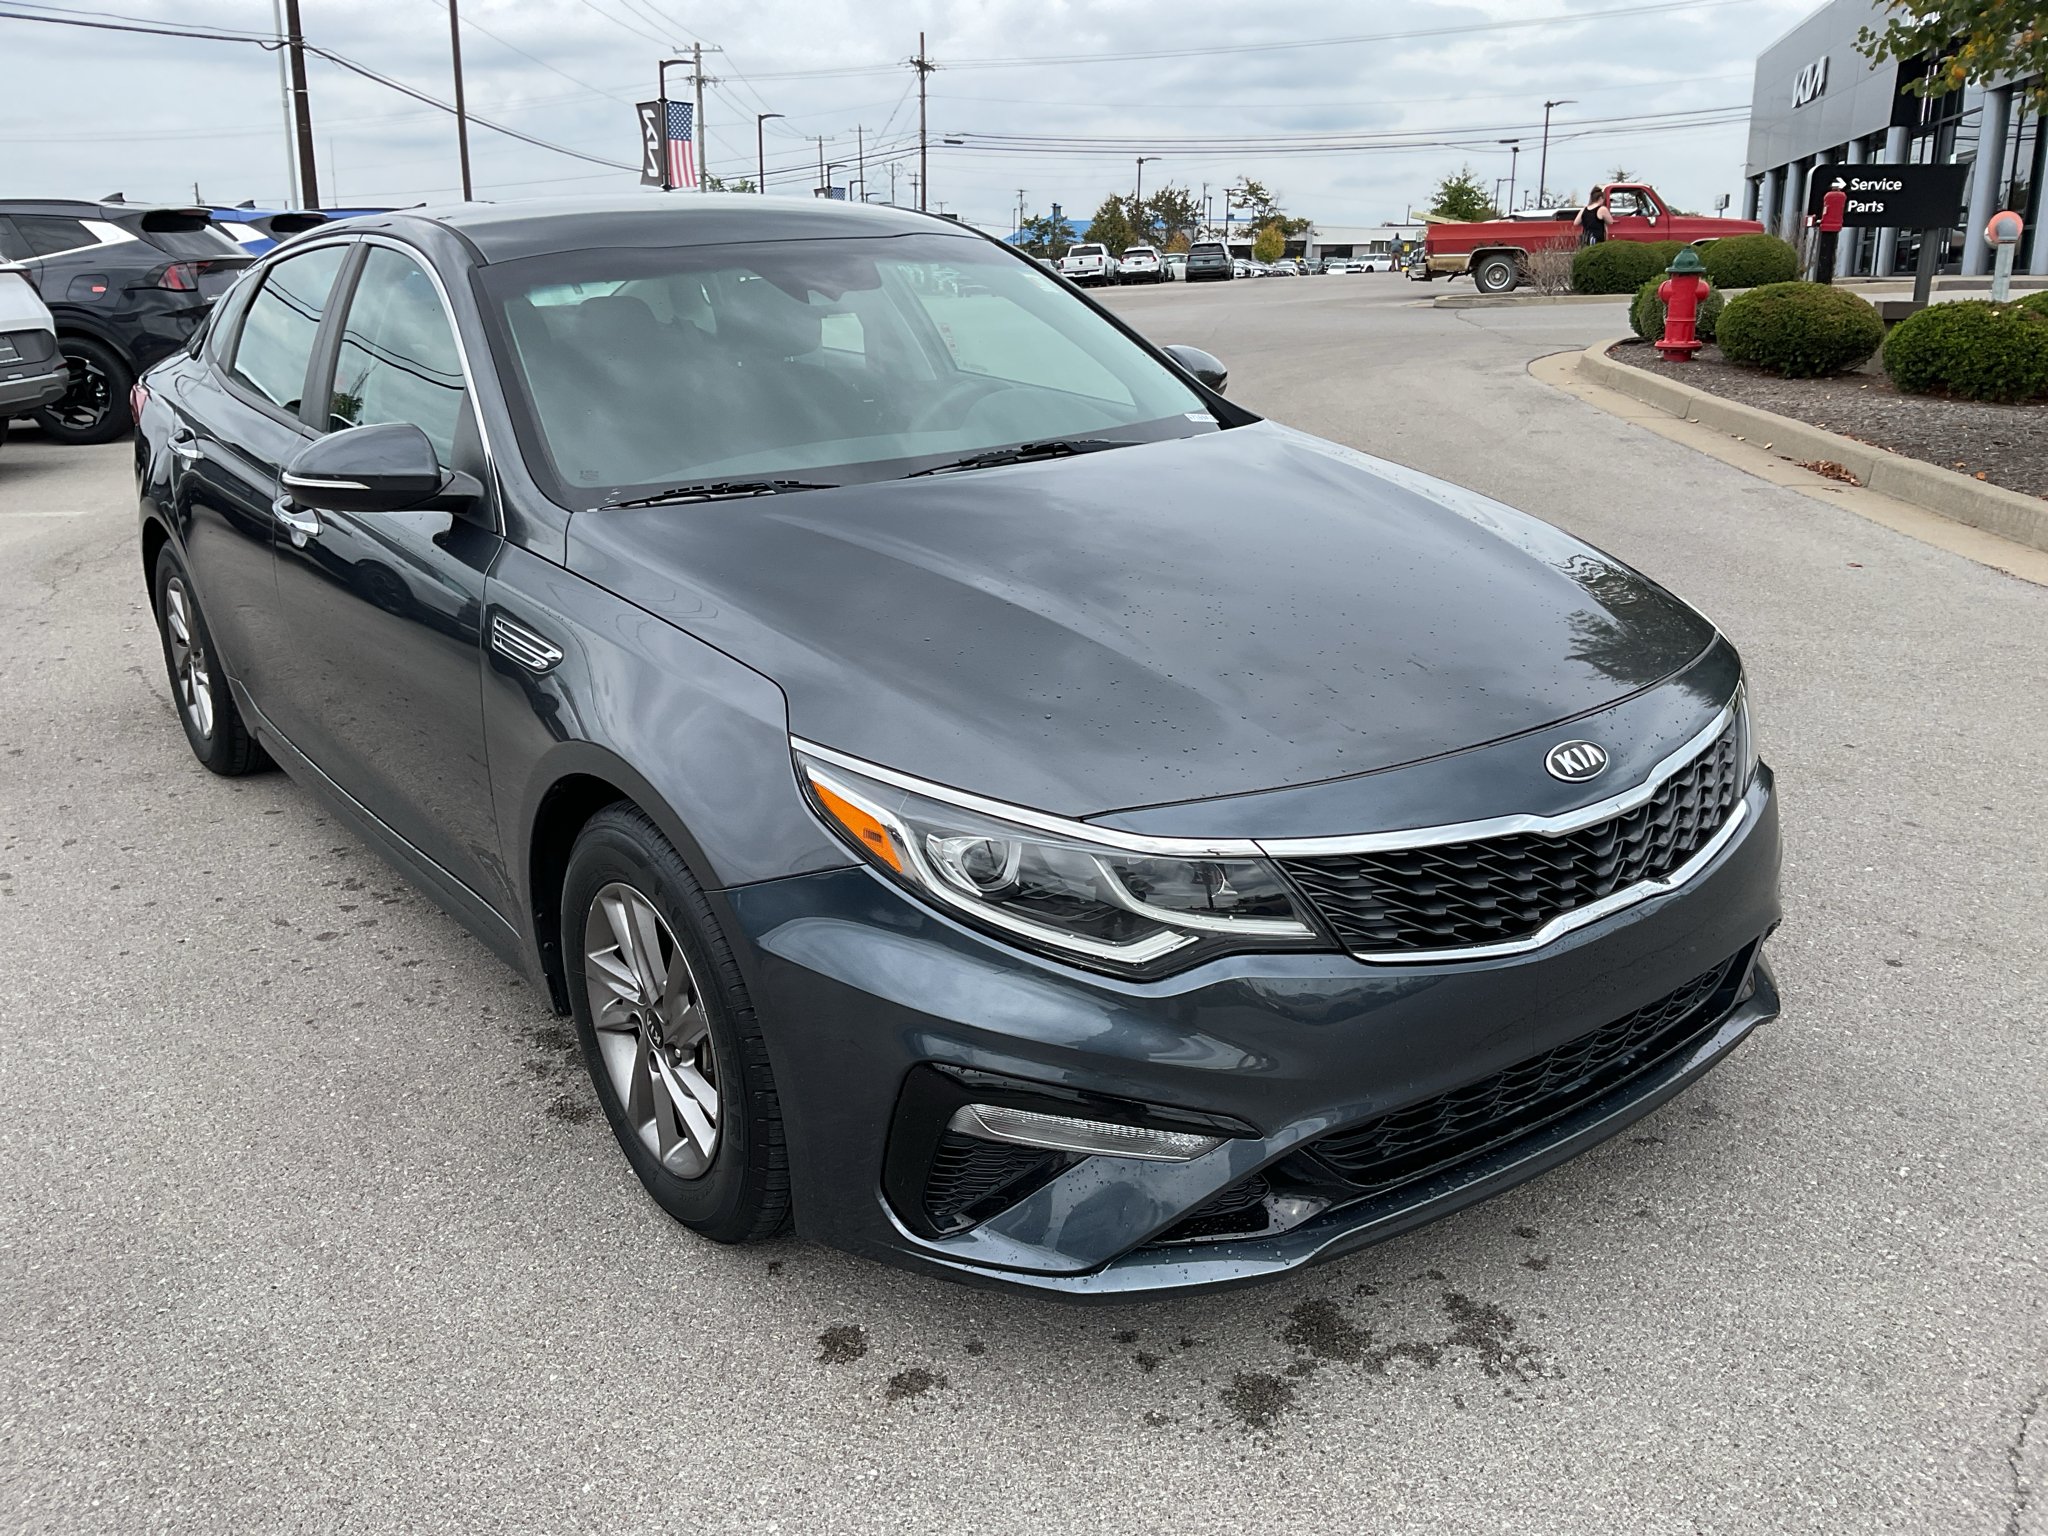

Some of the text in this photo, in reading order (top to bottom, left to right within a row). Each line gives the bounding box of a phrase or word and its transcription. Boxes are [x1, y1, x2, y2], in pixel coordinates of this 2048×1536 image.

[1851, 178, 1902, 190] Service
[1848, 200, 1884, 212] Parts
[1554, 744, 1605, 775] KIA
[646, 1013, 661, 1045] KIA
